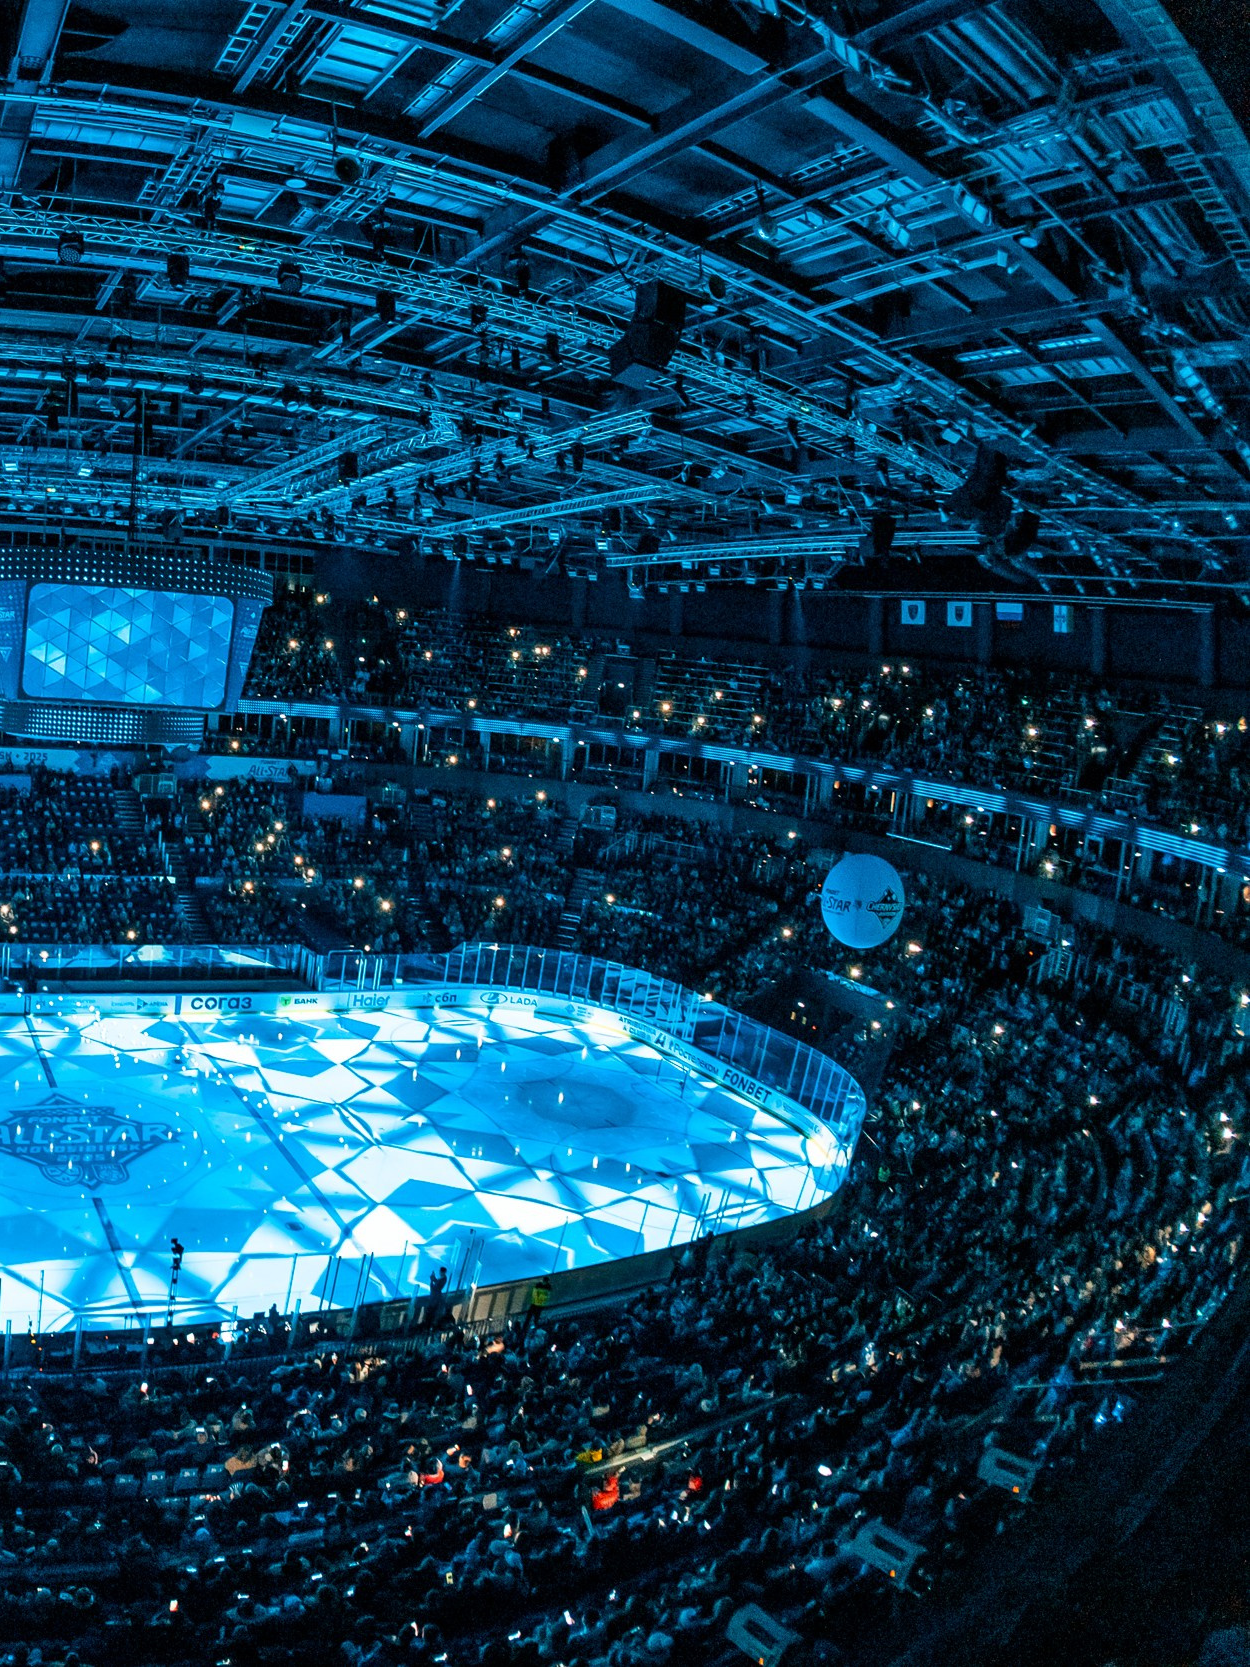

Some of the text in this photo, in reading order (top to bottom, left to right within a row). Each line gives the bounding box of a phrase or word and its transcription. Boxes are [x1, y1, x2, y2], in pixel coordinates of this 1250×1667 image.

[23, 751, 49, 761] 2025
[352, 994, 390, 1007] Haier
[435, 992, 457, 1003] сбп
[510, 996, 538, 1007] LADA
[674, 1042, 719, 1074] Ростелеком
[722, 1069, 772, 1103] FONBET
[27, 1115, 102, 1124] FONBET
